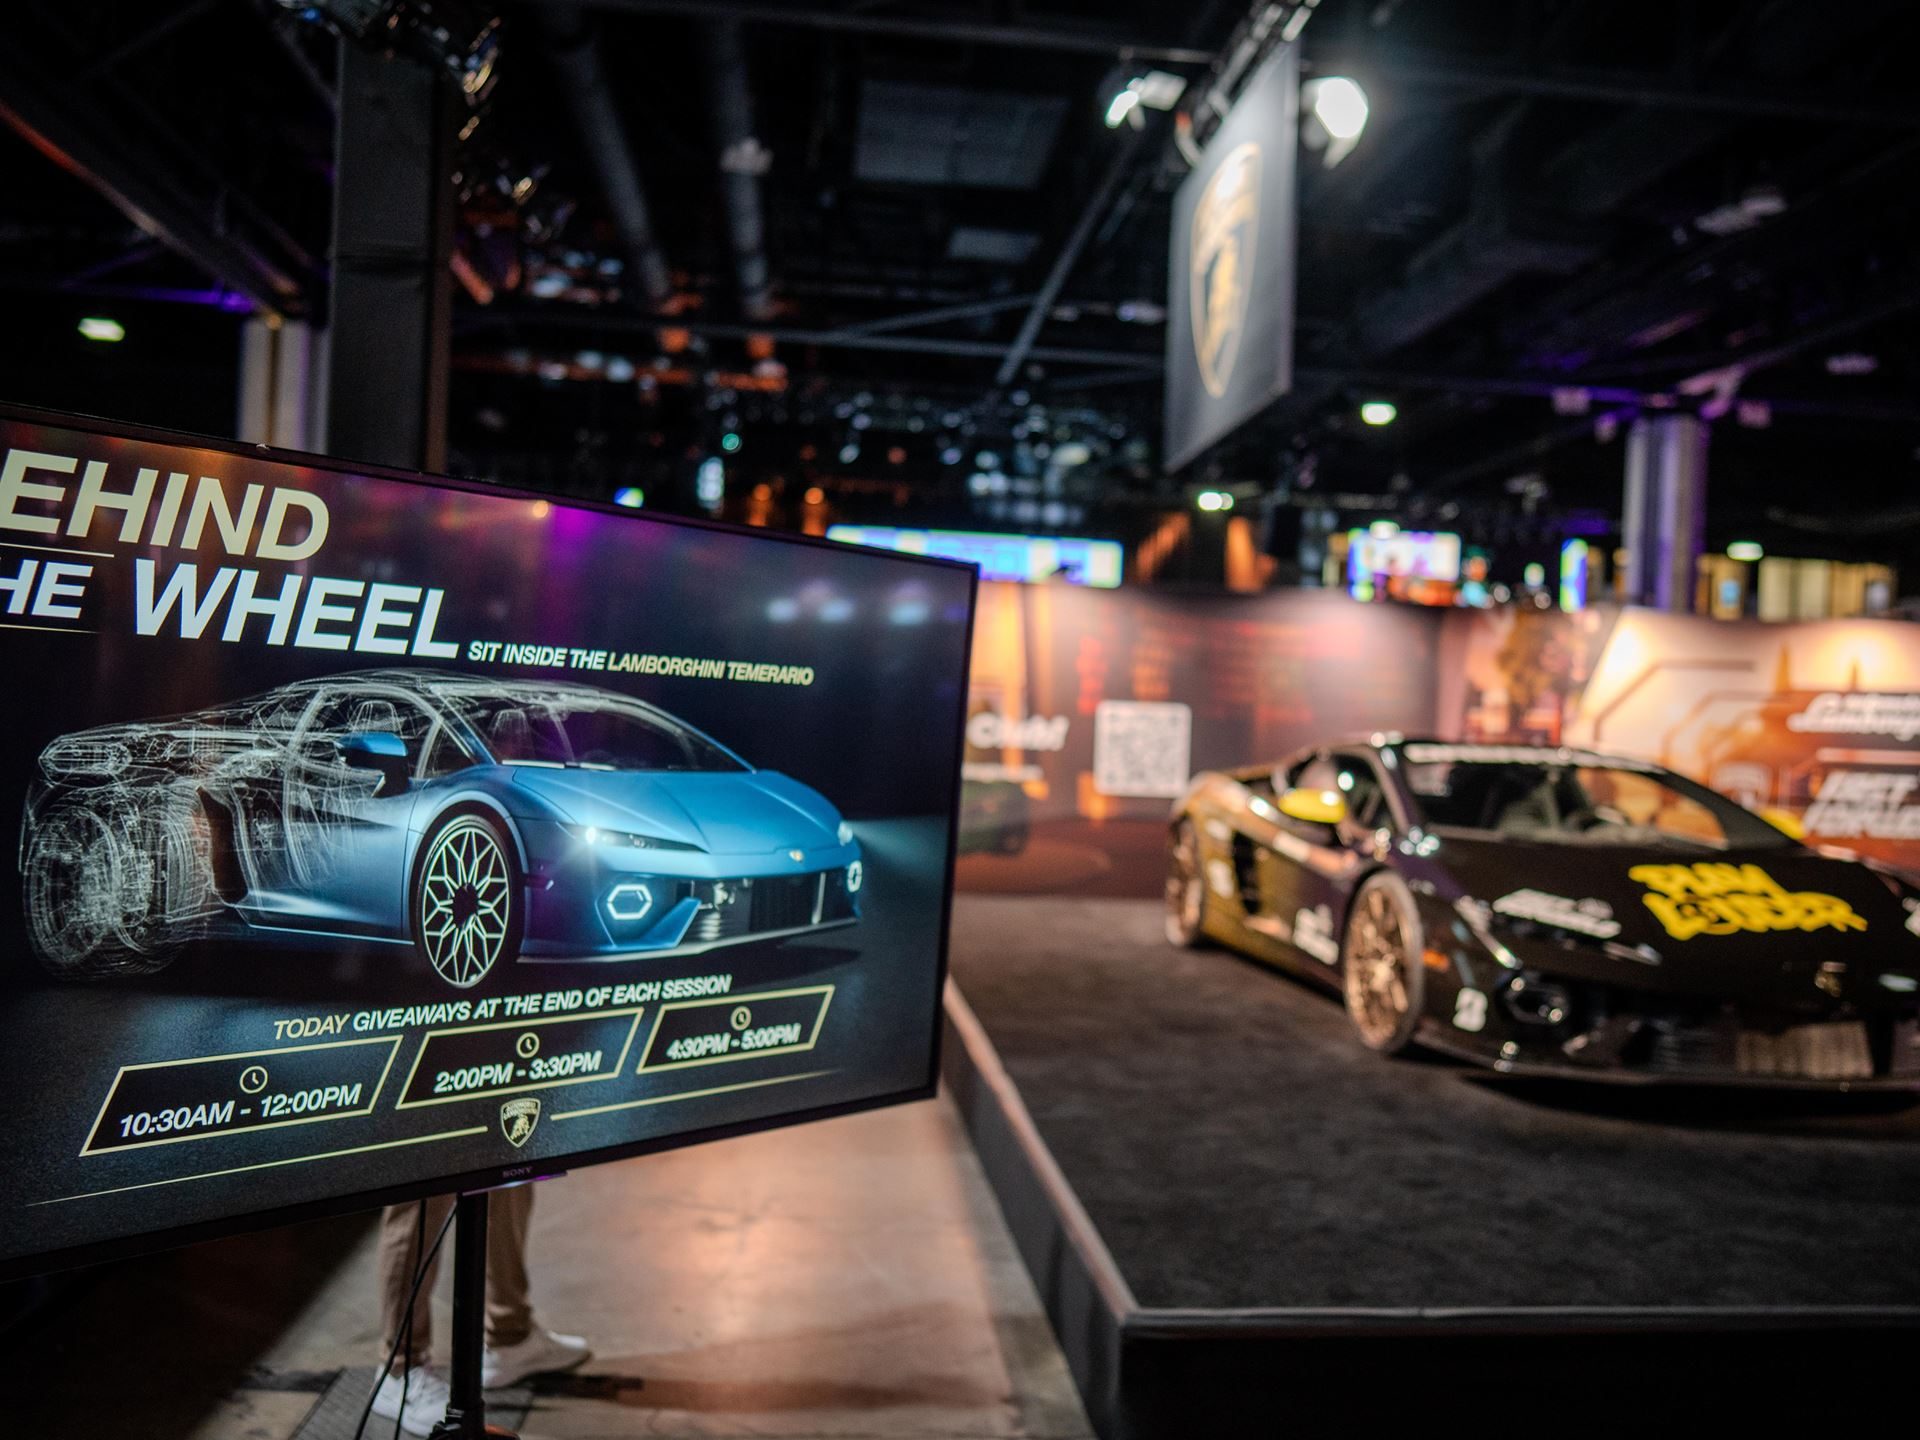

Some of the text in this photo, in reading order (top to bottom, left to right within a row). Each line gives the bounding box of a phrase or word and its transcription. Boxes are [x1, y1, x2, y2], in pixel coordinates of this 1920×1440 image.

[135, 558, 460, 660] WHEEL
[468, 640, 815, 686] SIT INSIDE THE LAMBORGHINI TEMERARIO
[274, 974, 732, 1040] TODAY GIVEAWAYS AT THE END OF EACH SESSION
[667, 1033, 731, 1061] 4:30PM
[741, 1023, 802, 1050] 5:00PM
[434, 1062, 514, 1094] 2:00PM
[528, 1050, 603, 1080] 3:30PM
[119, 1100, 235, 1138] 10:30AM
[260, 1083, 362, 1119] 12:00PM
[503, 1166, 532, 1178] SONY
